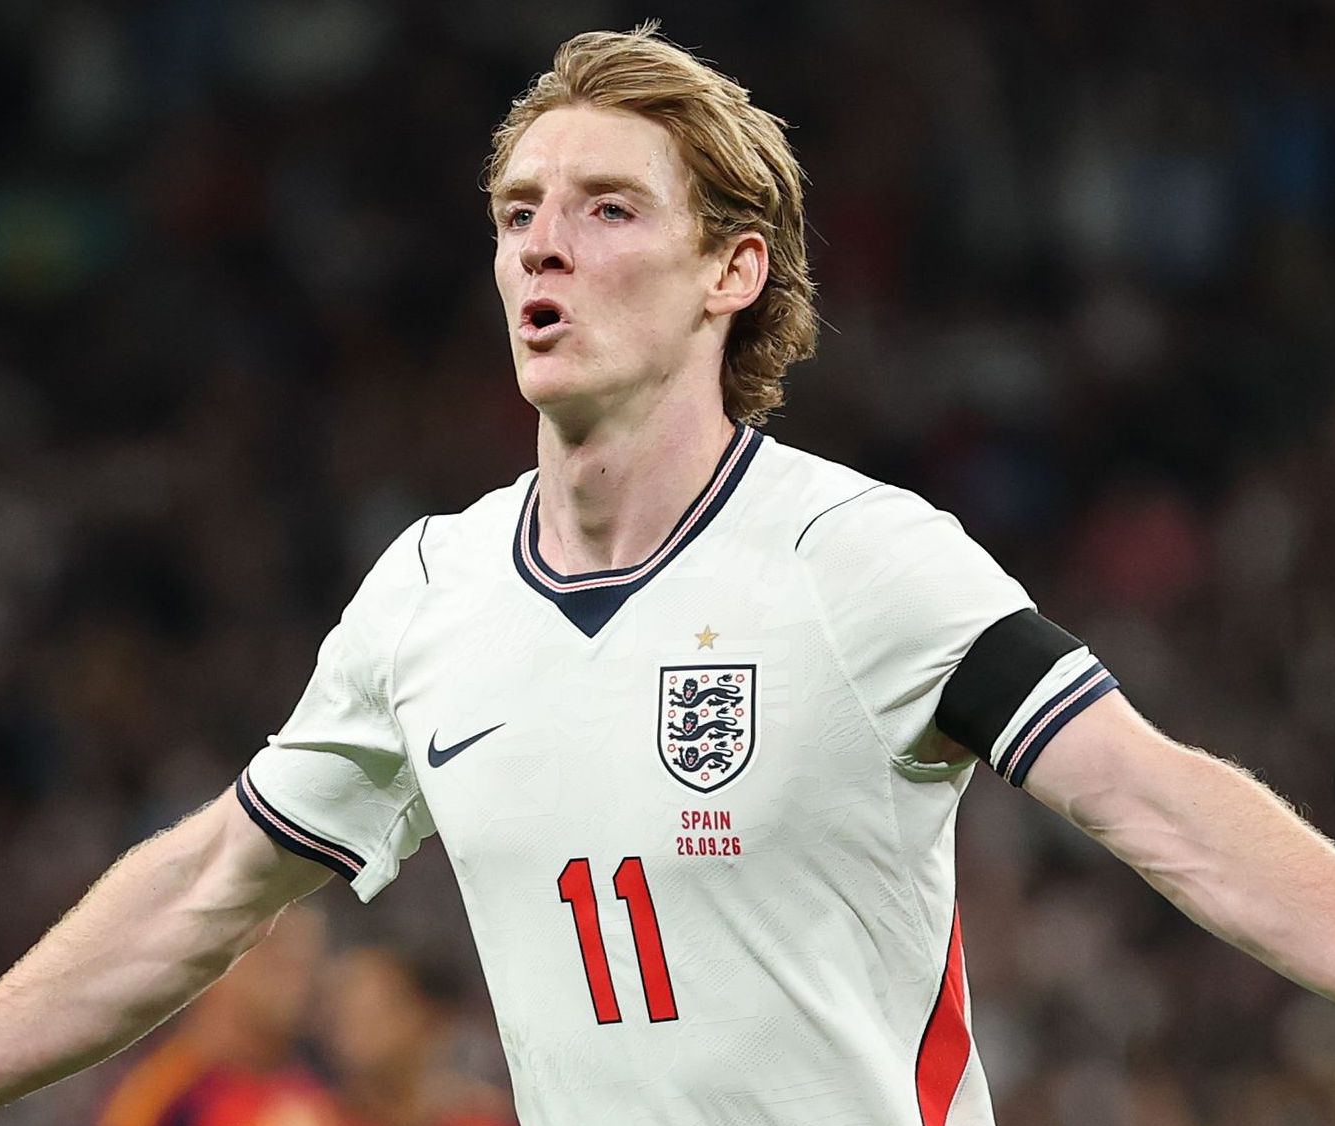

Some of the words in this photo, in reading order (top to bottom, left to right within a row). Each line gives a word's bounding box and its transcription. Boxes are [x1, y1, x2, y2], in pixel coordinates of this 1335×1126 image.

[681, 811, 731, 829] SPAIN
[676, 837, 741, 856] 26.09.26
[557, 856, 679, 1025] 11
